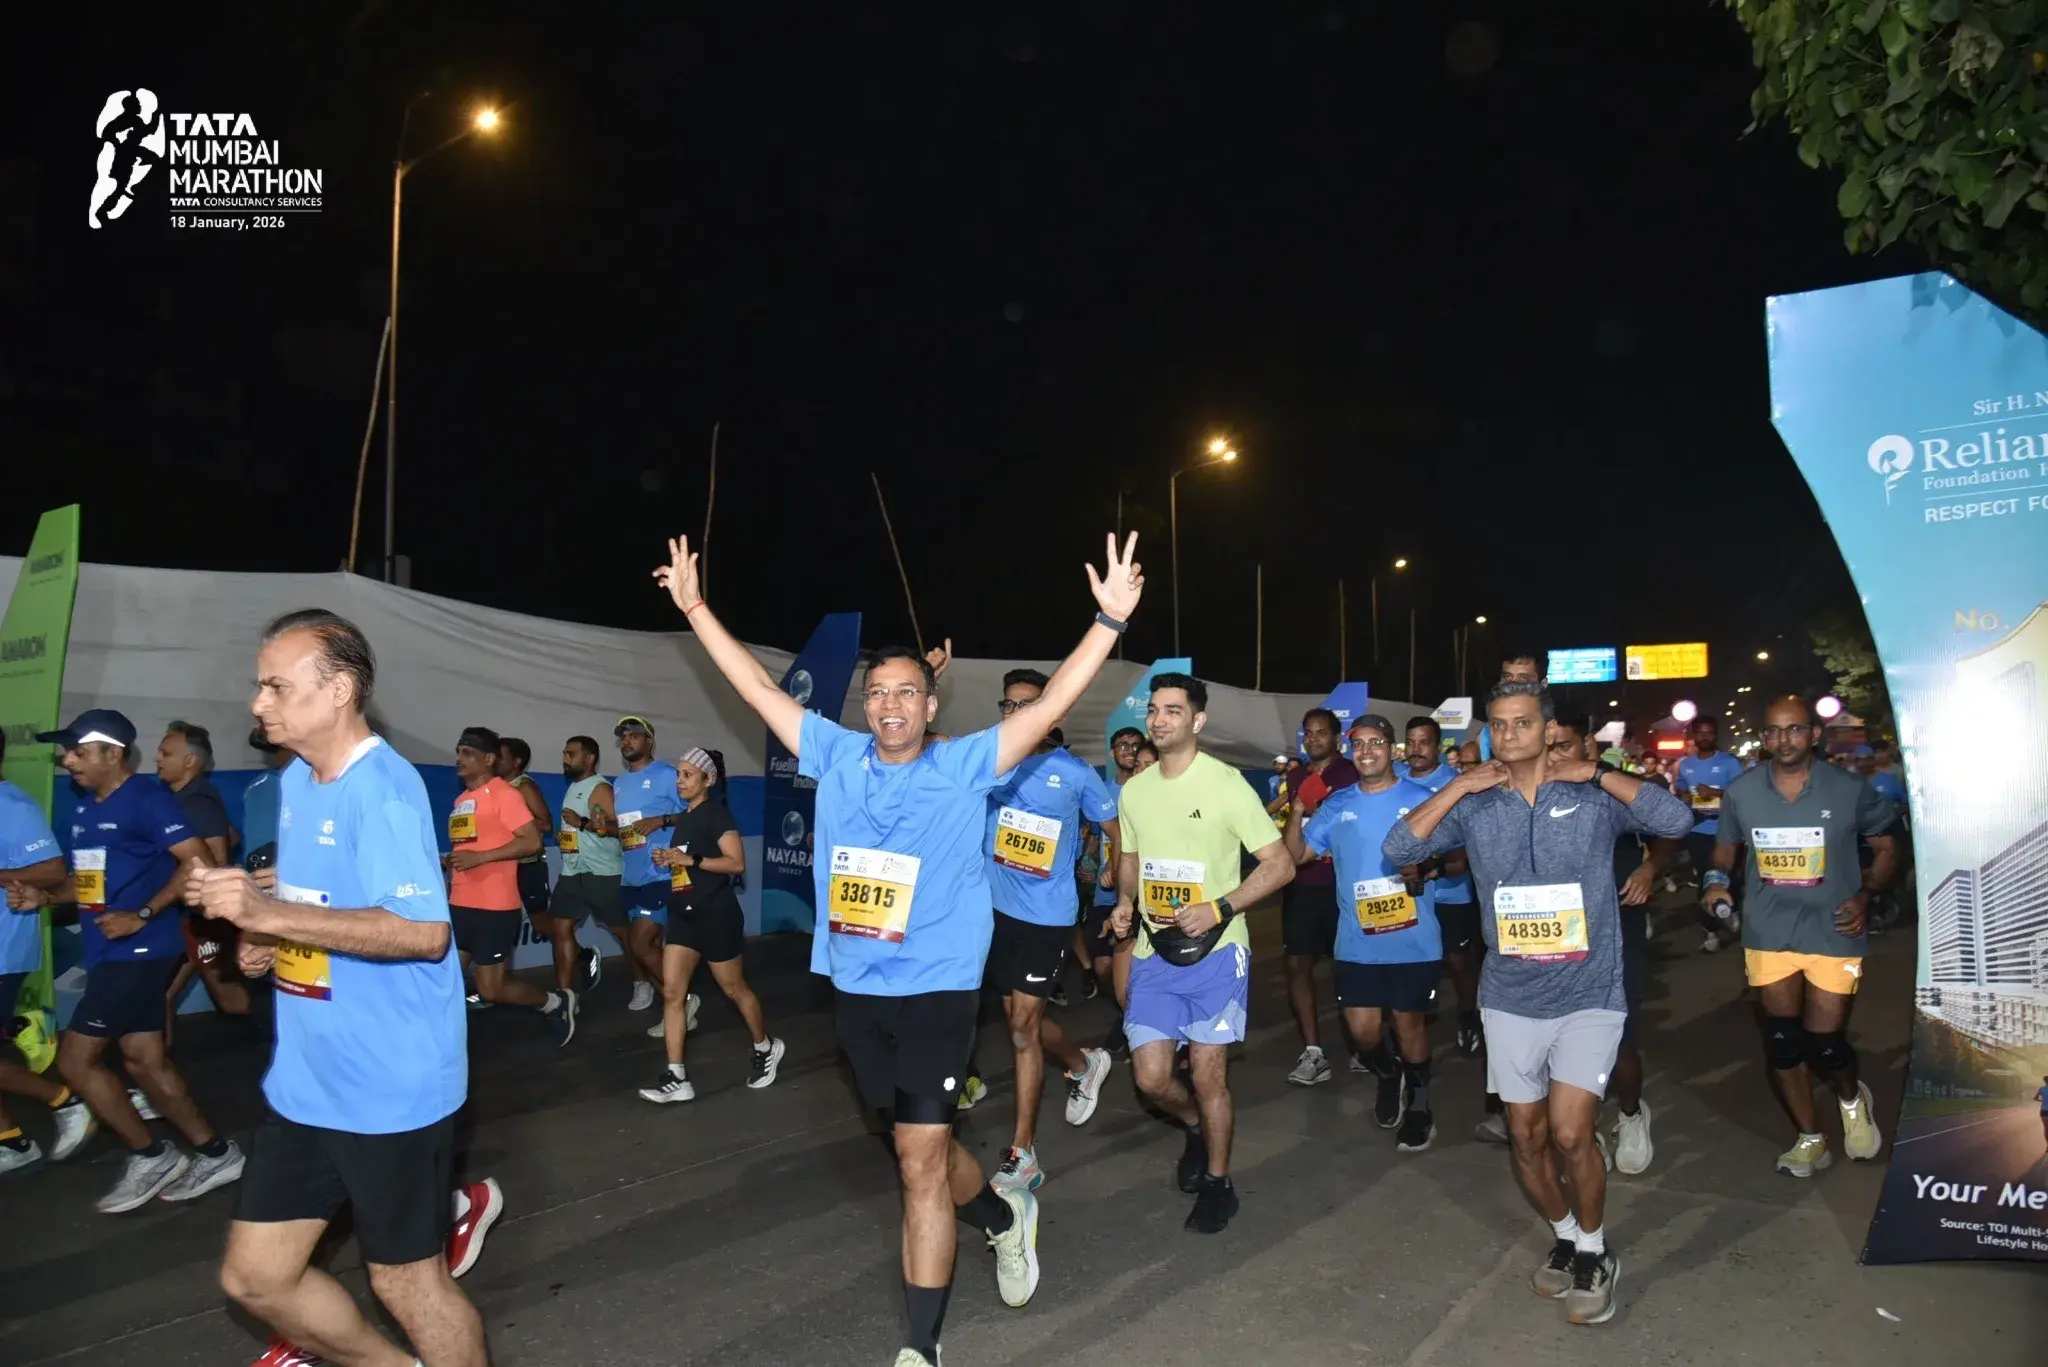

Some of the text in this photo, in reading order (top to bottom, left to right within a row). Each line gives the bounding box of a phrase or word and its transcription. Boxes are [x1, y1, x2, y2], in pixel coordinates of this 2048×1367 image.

[1973, 400, 2001, 415] Sir
[2007, 395, 2031, 411] H.
[1923, 468, 2030, 490] Foundation
[1925, 498, 2020, 523] RESPECT
[1004, 832, 1046, 855] 26796
[767, 846, 813, 867] NAYARA
[1763, 854, 1806, 868] 48370
[840, 881, 896, 908] 33815
[1151, 885, 1191, 903] 37379
[1366, 896, 1406, 915] 29222
[1507, 921, 1563, 939] 48393
[1912, 1174, 2048, 1210] Your Me
[1940, 1218, 1984, 1231] Source:
[1987, 1223, 2008, 1234] TOI
[1976, 1234, 2028, 1249] Lifestyle
